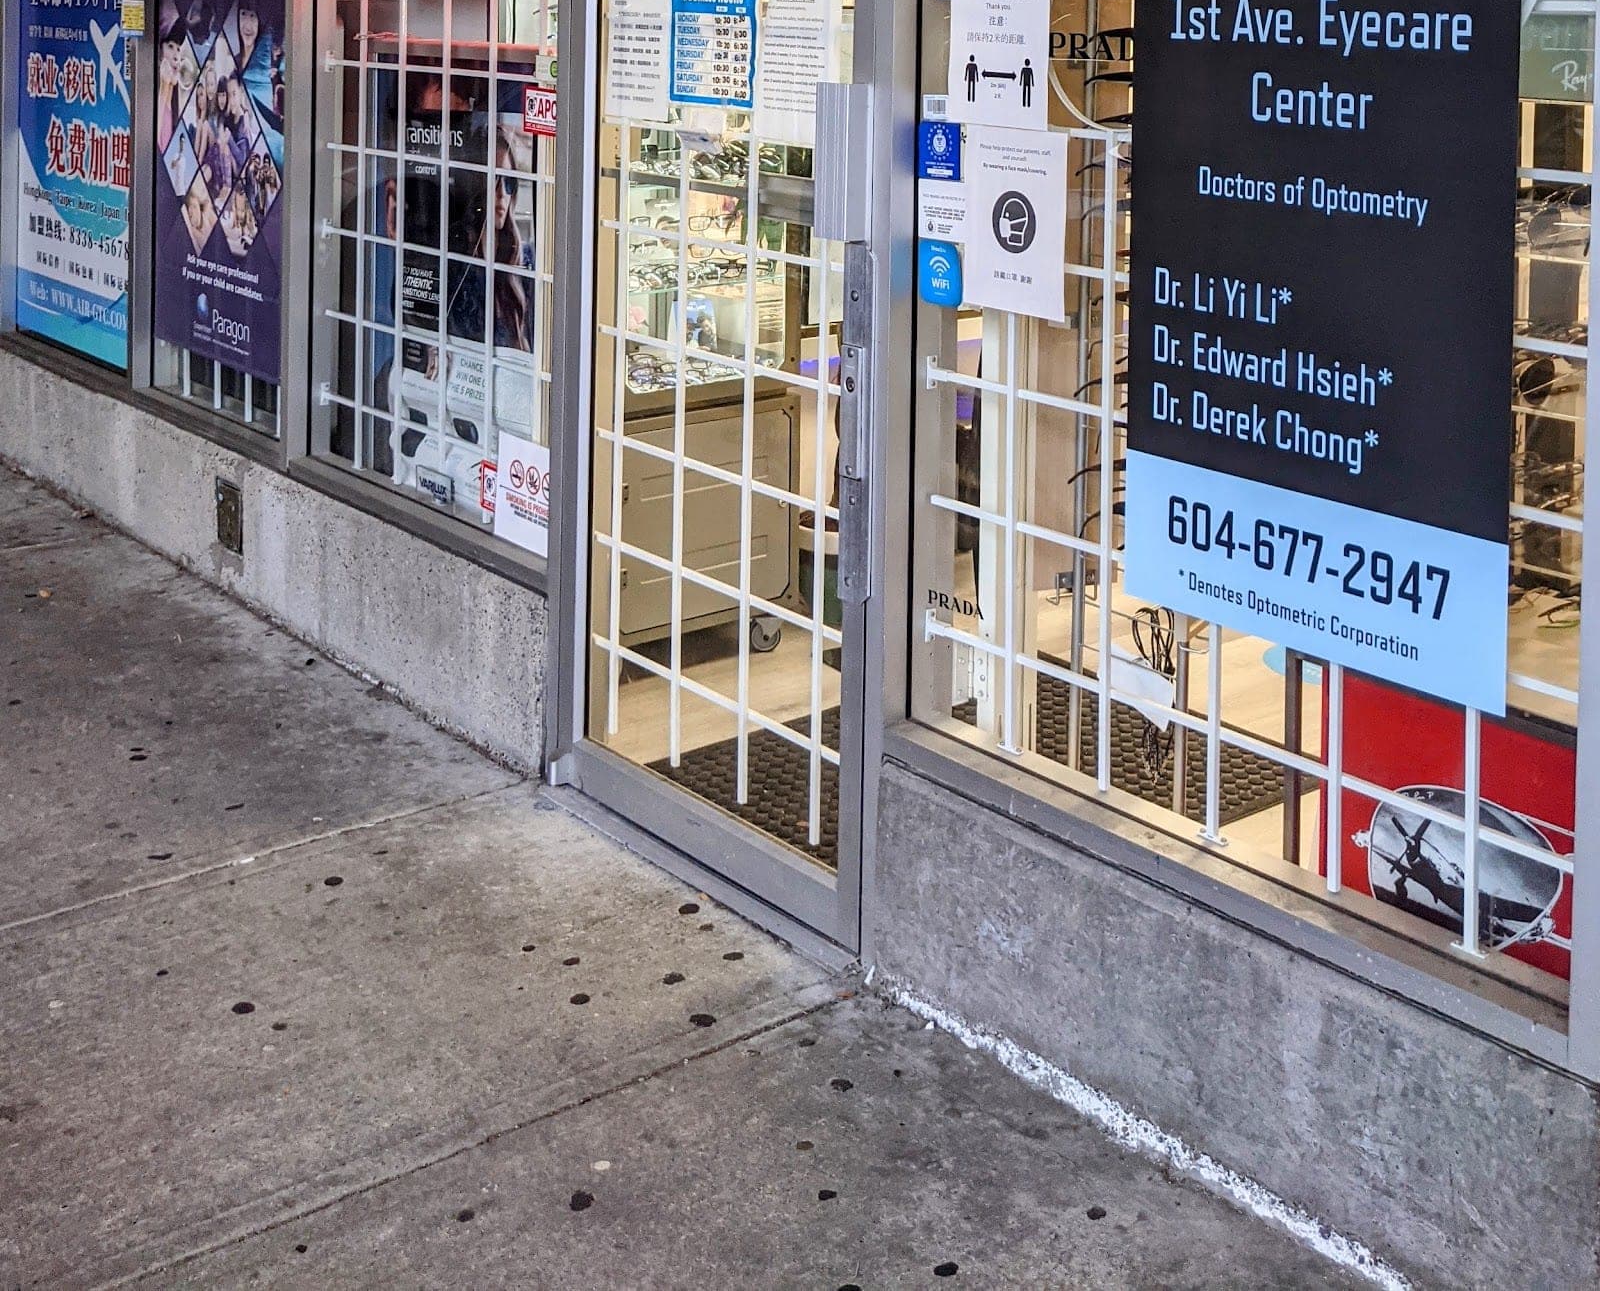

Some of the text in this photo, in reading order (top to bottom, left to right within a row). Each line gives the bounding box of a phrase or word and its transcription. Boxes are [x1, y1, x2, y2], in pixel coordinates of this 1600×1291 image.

[677, 14, 700, 23] MONDAY
[677, 26, 700, 35] TUESDAY
[677, 37, 709, 47] WEDNESDAY
[1049, 32, 1136, 62] PRAD
[677, 49, 704, 59] THURSDAY
[676, 61, 694, 70] FRIDAY
[676, 73, 703, 83] SATURDAY
[676, 85, 697, 94] SUNDAY
[1251, 71, 1373, 130] Center
[406, 124, 463, 148] ransitins
[45, 114, 131, 189] 免费加盟
[415, 165, 437, 176] control
[1198, 165, 1428, 227] Doctors of Optometry
[403, 275, 434, 290] UTHENTIC
[931, 277, 950, 290] WiFi
[1154, 266, 1184, 309] Dr.
[1194, 272, 1215, 315] Li
[1222, 276, 1246, 320] Yi
[212, 308, 251, 345] Paragon
[460, 358, 484, 373] CHANCE
[1153, 324, 1184, 368] Dr.
[1193, 332, 1287, 388] Edward
[469, 374, 482, 387] ONE
[1152, 382, 1183, 427] Dr.
[1192, 390, 1267, 446] Derek
[1168, 494, 1451, 621] 604-677-2947
[928, 589, 984, 620] PRADA
[1247, 590, 1326, 636] Optometric
[1330, 616, 1420, 662] Corporation
